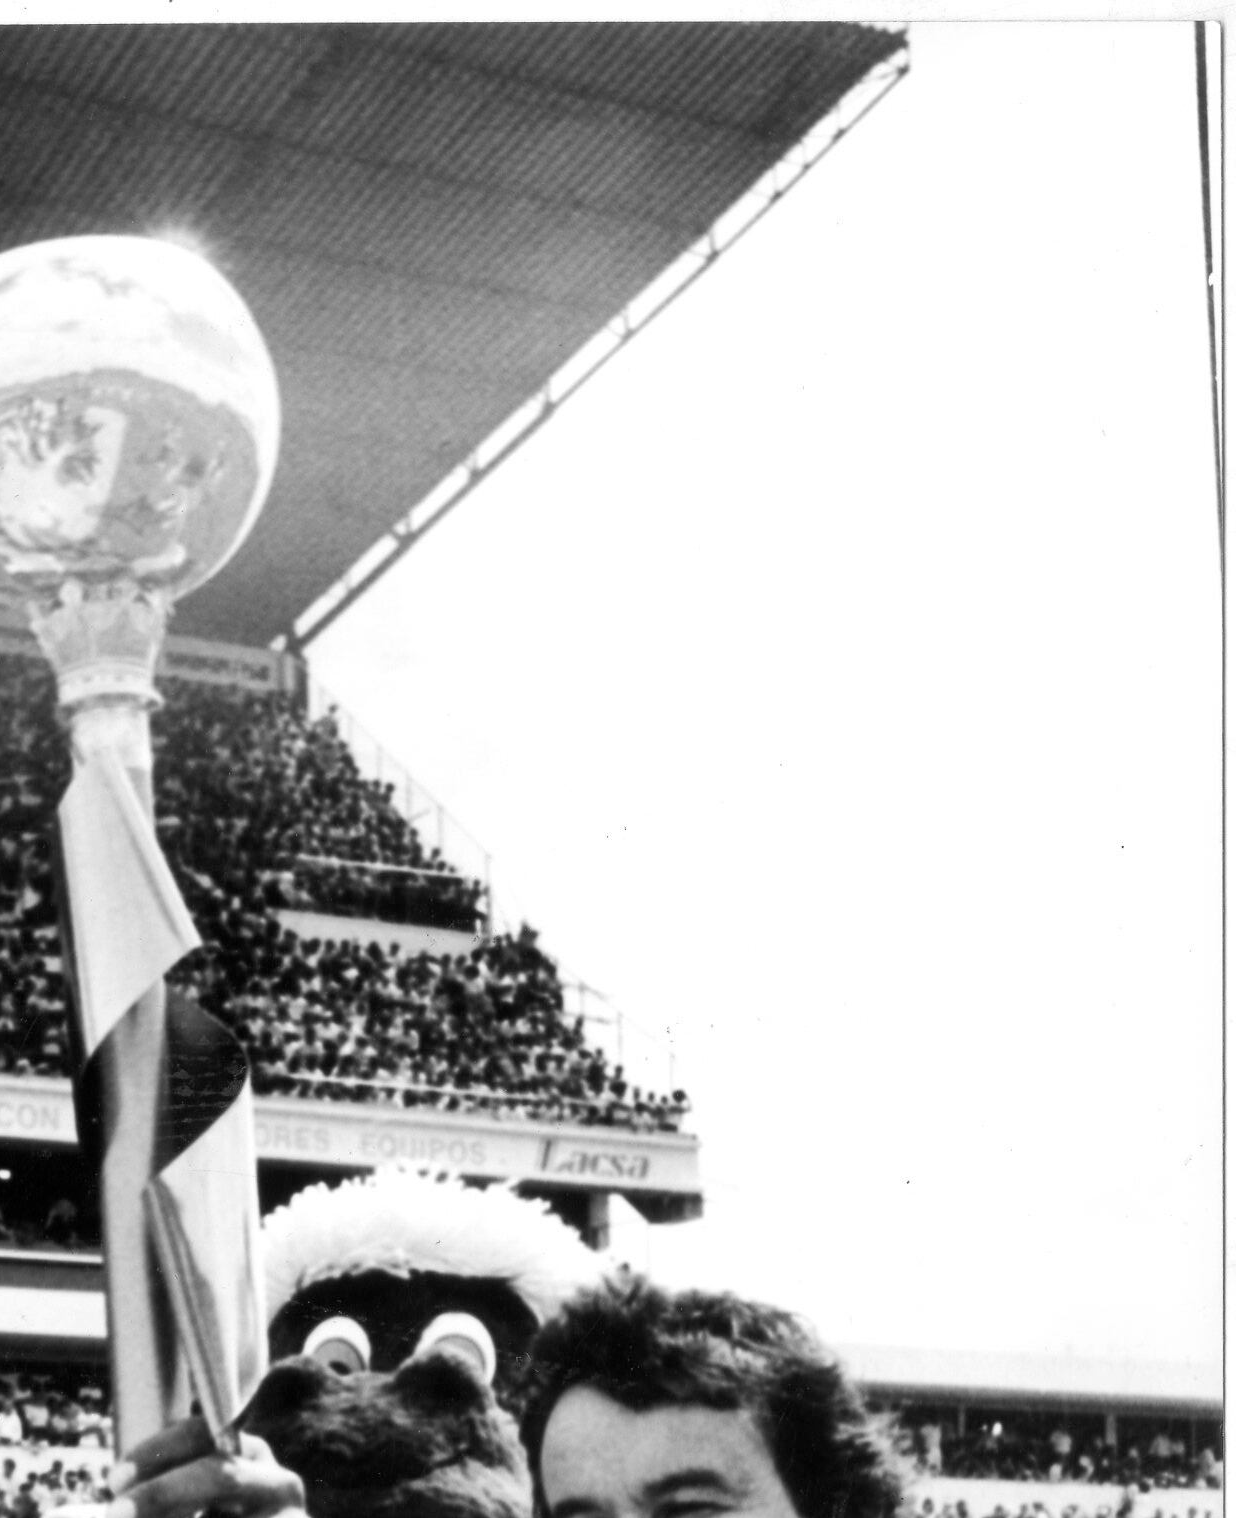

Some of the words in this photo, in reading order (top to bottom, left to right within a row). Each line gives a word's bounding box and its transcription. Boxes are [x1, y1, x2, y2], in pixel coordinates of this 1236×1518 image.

[254, 1121, 330, 1152] ORES
[360, 1132, 487, 1165] EQUIPOS
[540, 1139, 650, 1178] Lacsa
